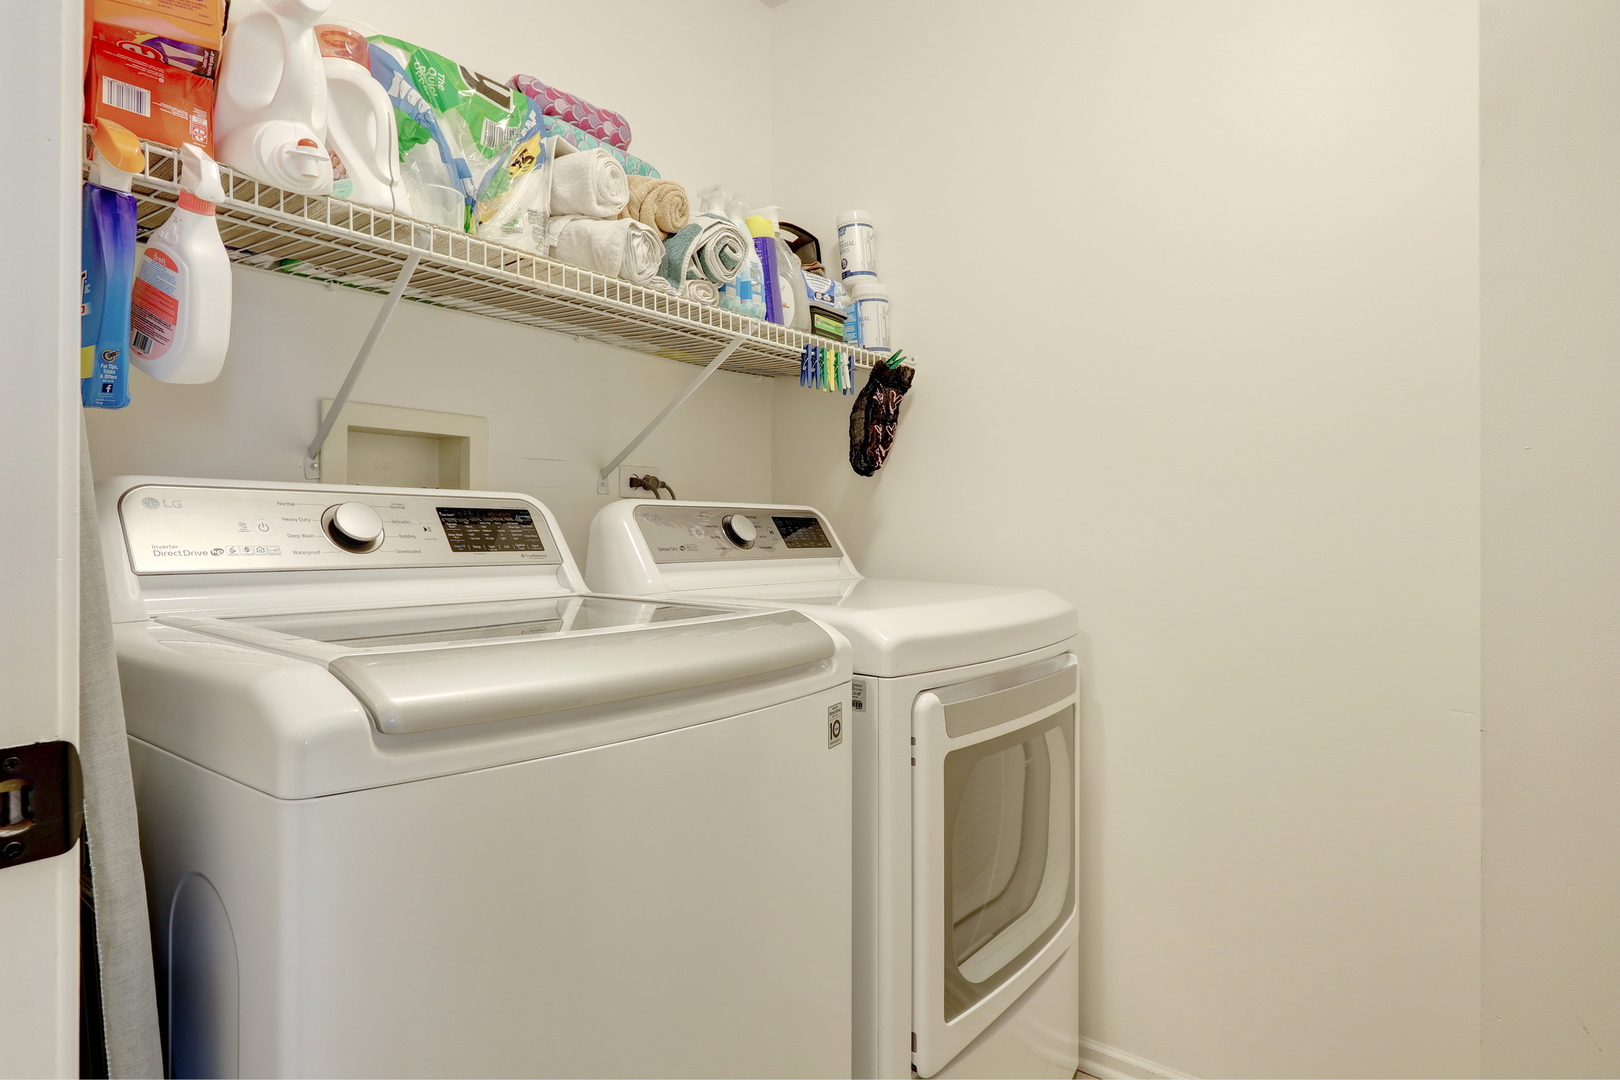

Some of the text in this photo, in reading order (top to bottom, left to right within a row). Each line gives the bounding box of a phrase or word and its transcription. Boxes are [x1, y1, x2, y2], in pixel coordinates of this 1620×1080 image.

[438, 72, 446, 92] The
[152, 252, 167, 266] dreft
[163, 499, 182, 509] LG
[830, 719, 841, 740] 10
